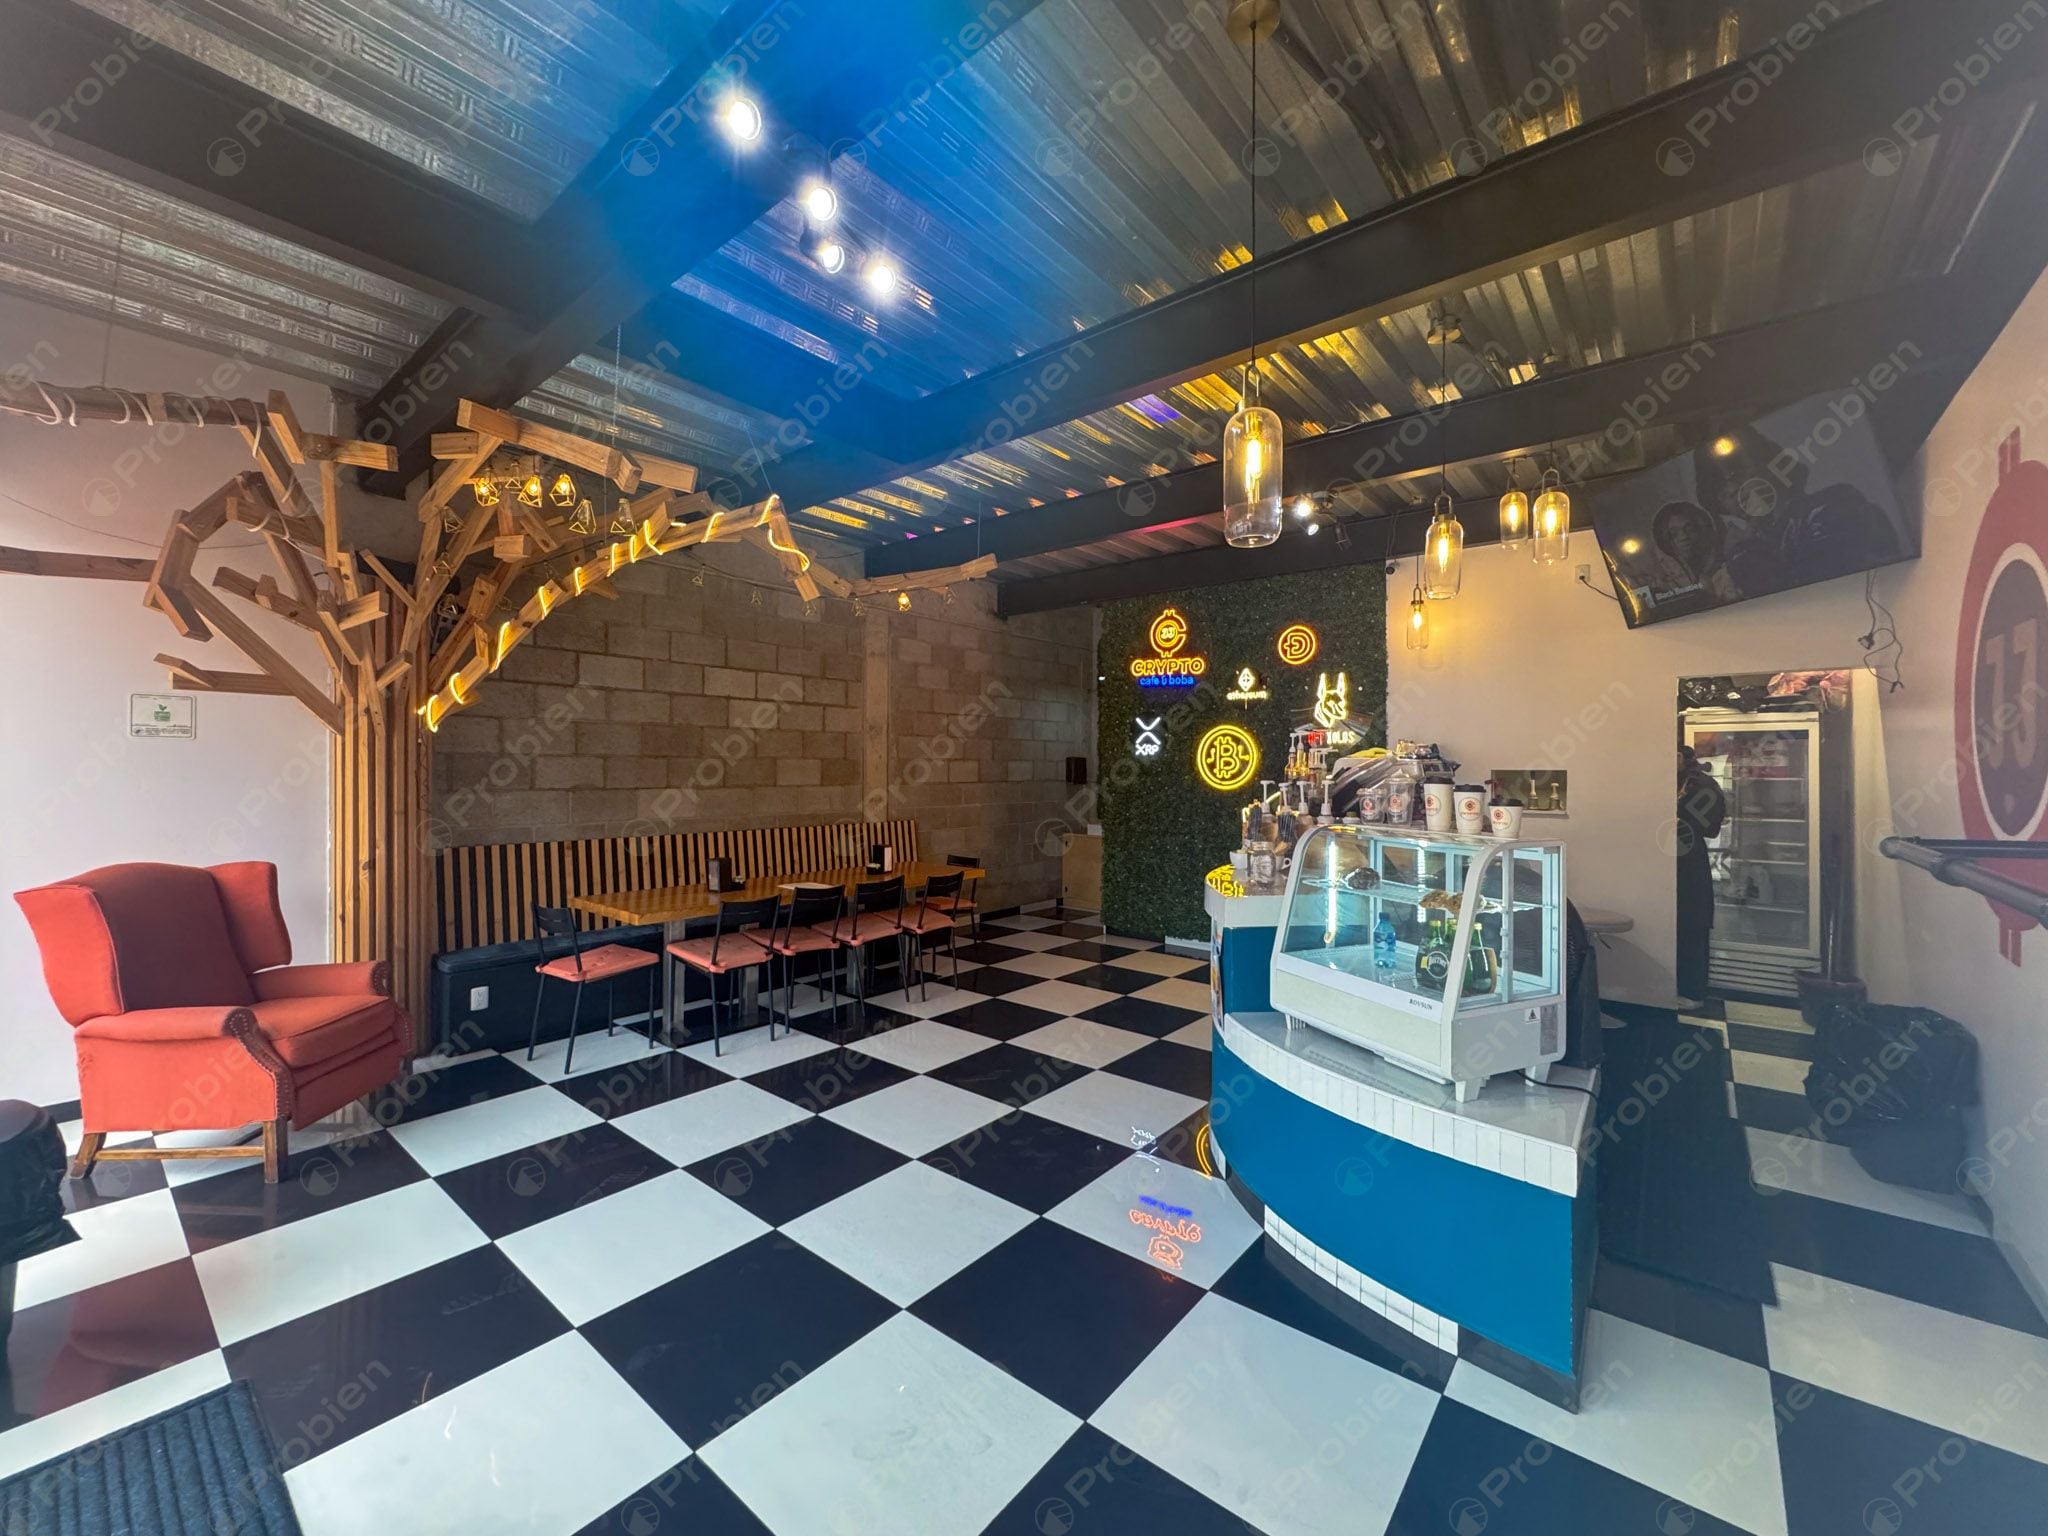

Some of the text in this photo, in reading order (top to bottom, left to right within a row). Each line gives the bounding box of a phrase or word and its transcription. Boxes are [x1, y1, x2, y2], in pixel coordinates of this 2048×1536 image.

[1131, 657, 1205, 677] CRYPTO
[1169, 674, 1194, 685] boba
[1135, 743, 1160, 756] XRP
